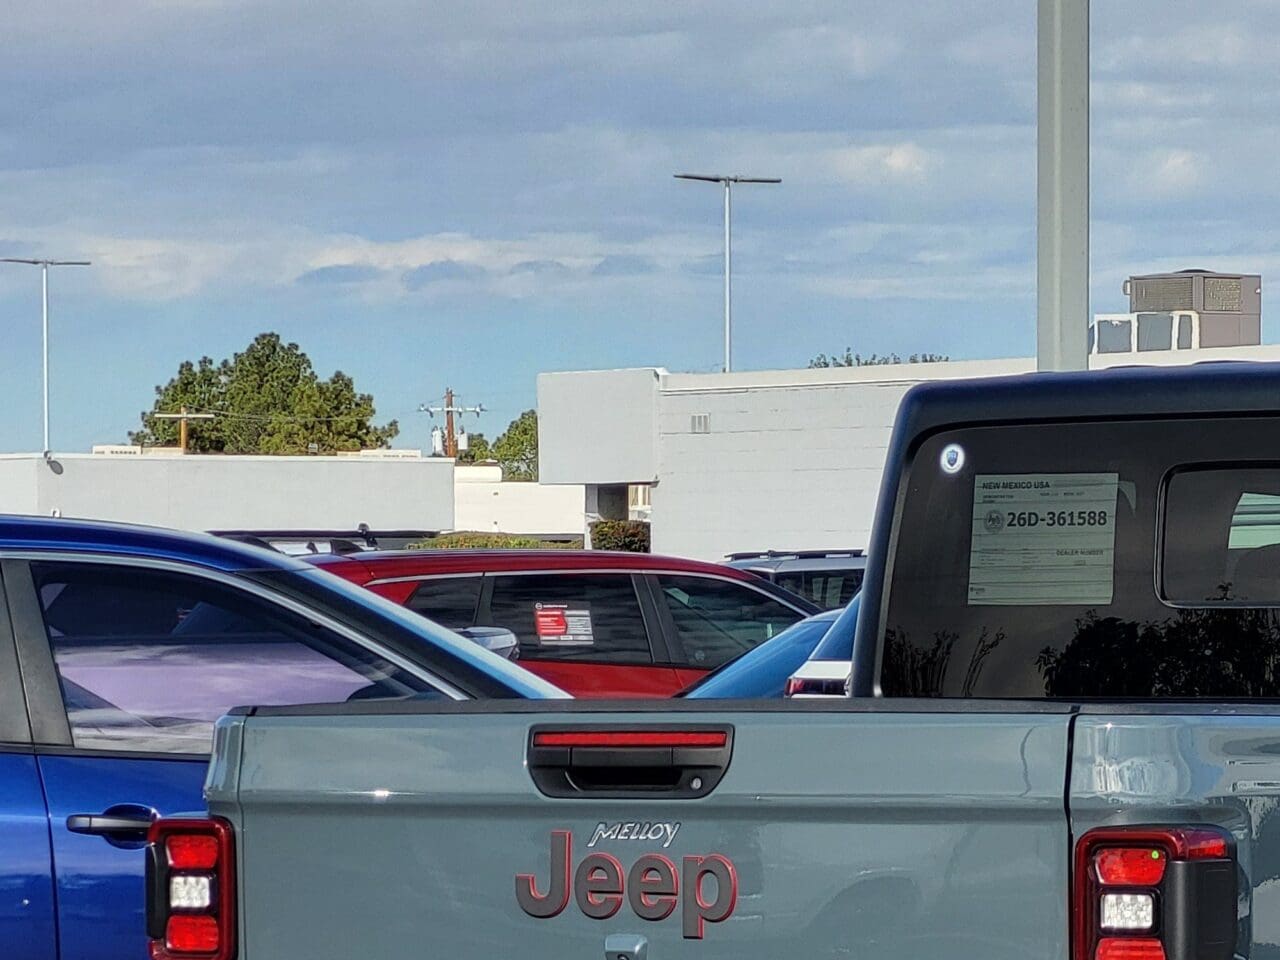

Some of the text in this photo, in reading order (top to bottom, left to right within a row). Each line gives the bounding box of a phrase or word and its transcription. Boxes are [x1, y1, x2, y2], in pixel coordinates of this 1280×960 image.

[982, 481, 1050, 490] NEW MEXICO USA
[1007, 511, 1107, 527] 26D-361588
[515, 829, 739, 940] Jeep
